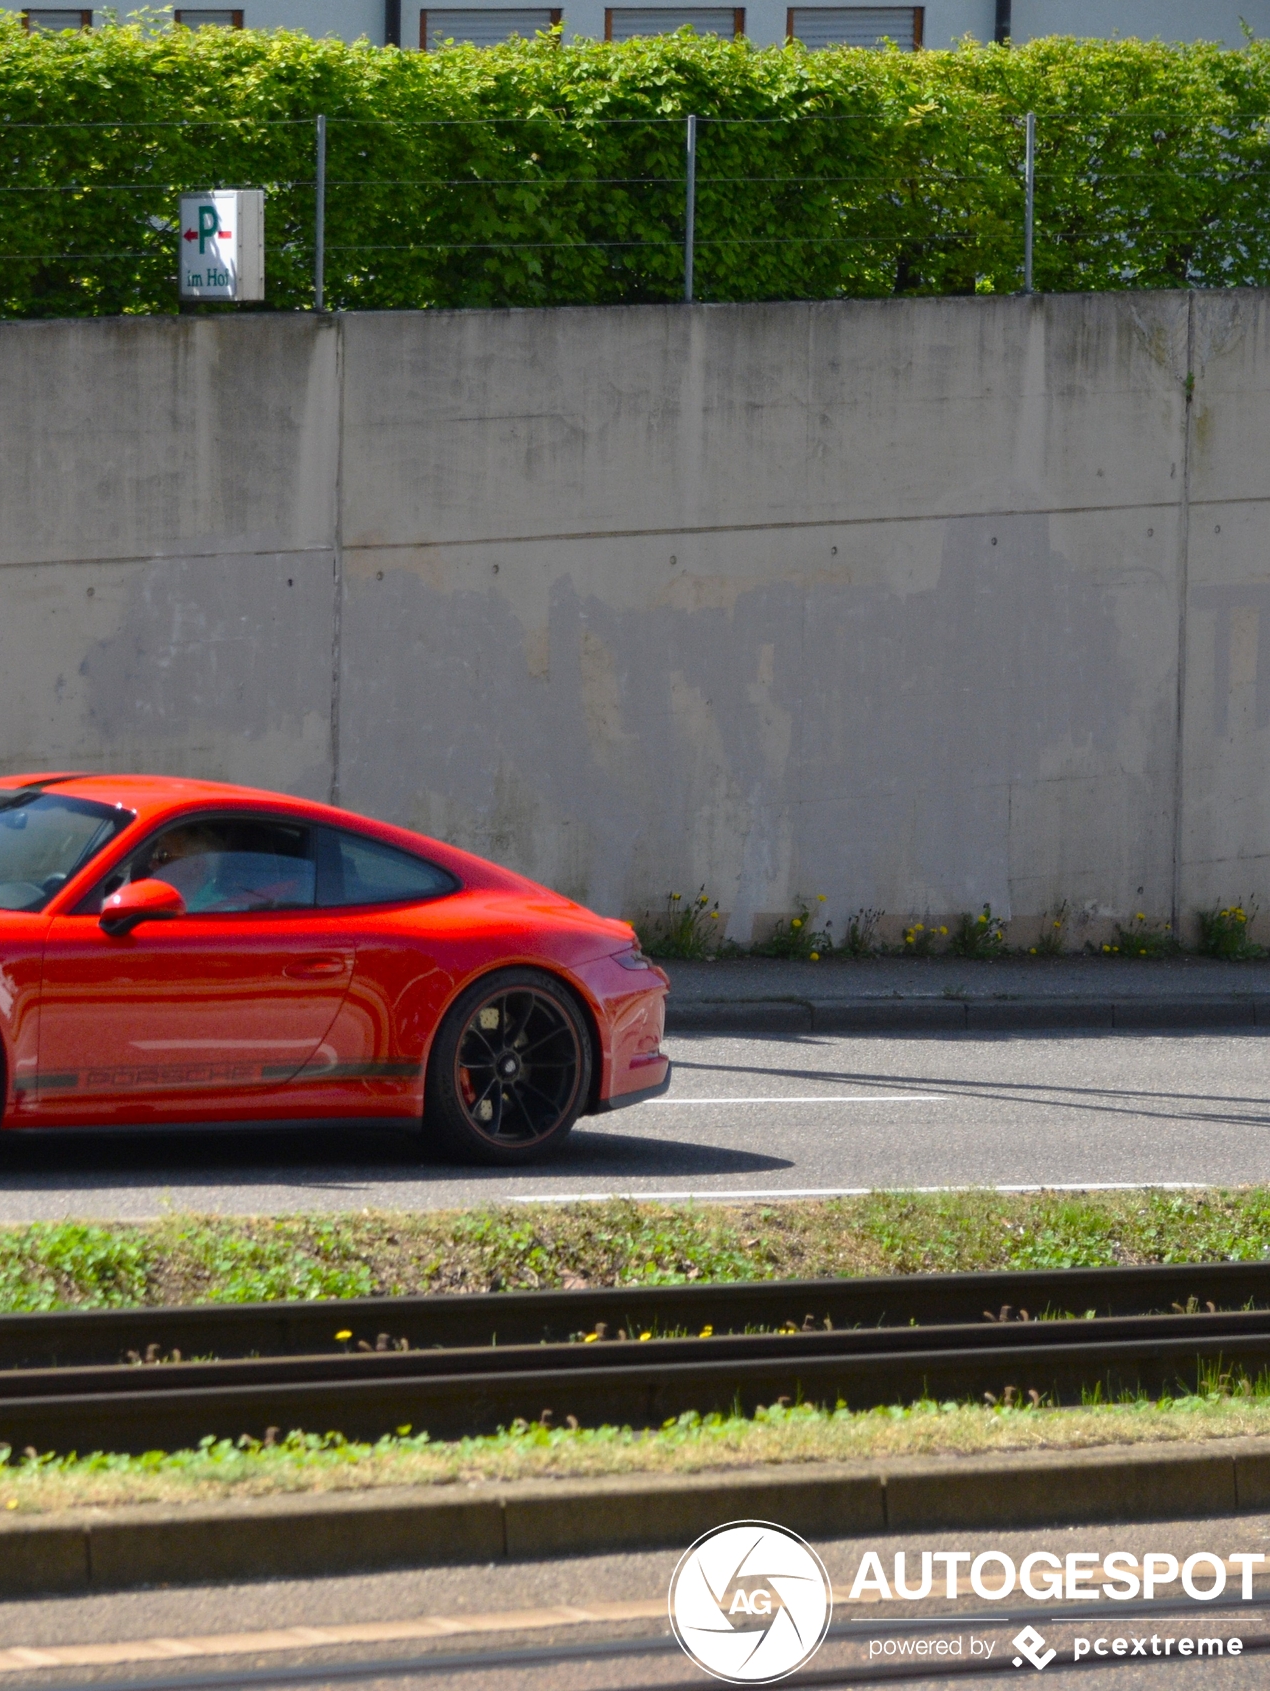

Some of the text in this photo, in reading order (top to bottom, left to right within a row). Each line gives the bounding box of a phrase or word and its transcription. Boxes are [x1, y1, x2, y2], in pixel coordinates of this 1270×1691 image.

[198, 205, 219, 255] P
[187, 268, 230, 287] im Hof
[84, 1065, 256, 1088] PORSCHE
